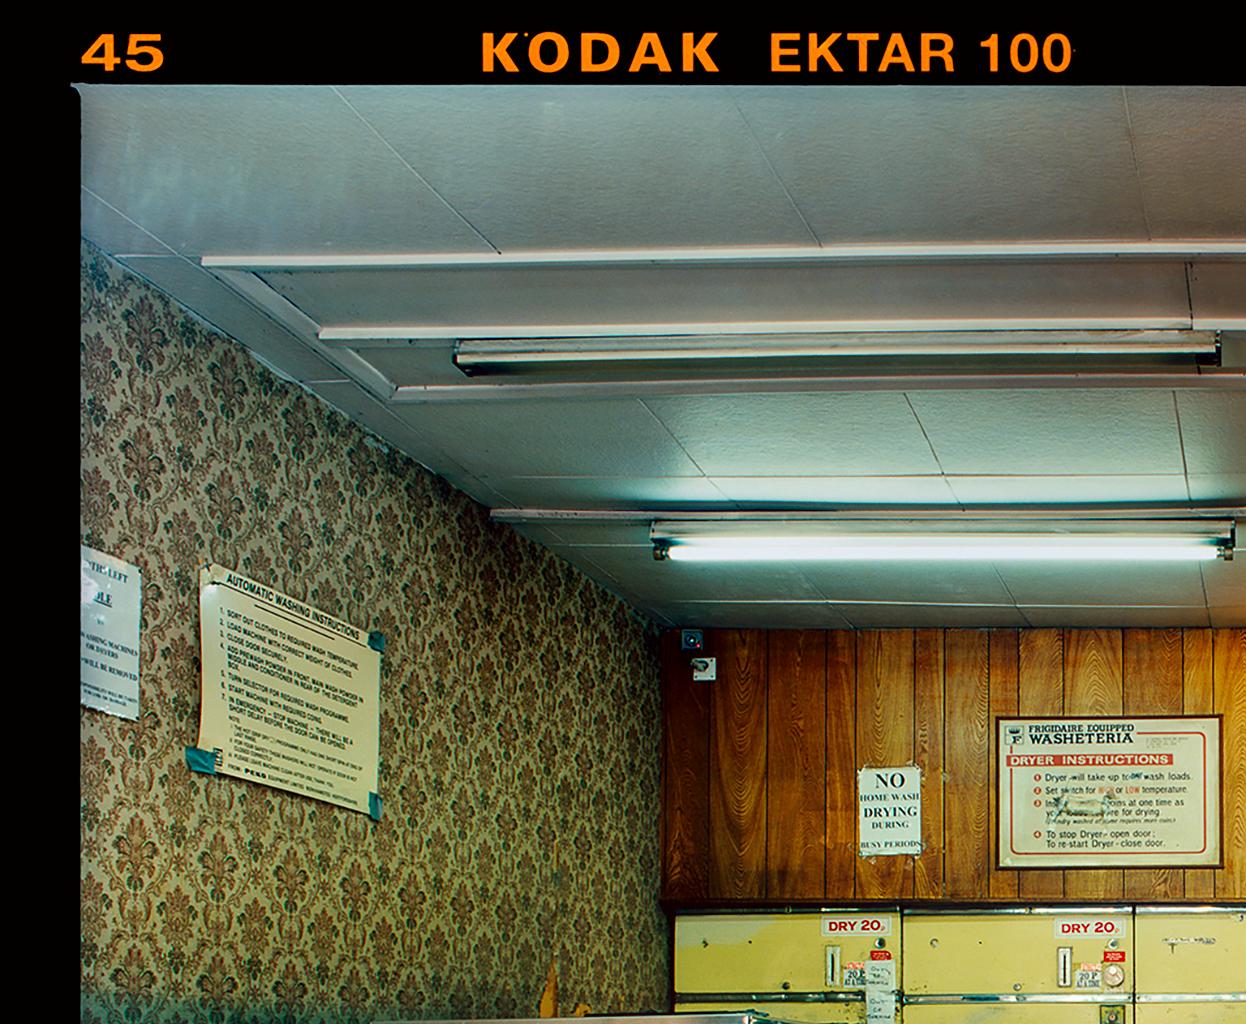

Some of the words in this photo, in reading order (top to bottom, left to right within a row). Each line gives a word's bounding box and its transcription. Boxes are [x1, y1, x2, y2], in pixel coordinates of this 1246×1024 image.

[226, 573, 274, 601] AUTOMATIC
[274, 594, 311, 618] WASHING
[312, 611, 359, 640] INSTRUCTIONS
[1028, 725, 1084, 733] FRIGIDAIRE
[1087, 724, 1134, 733] EQUIPPED
[1028, 733, 1134, 744] WASHETERIA
[1010, 756, 1054, 766] DRYER
[1062, 754, 1169, 765] INSTRUCTIONS
[875, 772, 906, 789] NO
[1045, 773, 1067, 783] Dryer
[1087, 773, 1105, 781] take
[1107, 775, 1120, 783] up
[1143, 772, 1165, 780] wash
[1045, 786, 1058, 795] Set
[1085, 786, 1096, 794] for
[860, 793, 888, 802] HOME
[891, 792, 920, 801] WASH
[1128, 799, 1137, 807] at
[1138, 799, 1153, 807] one
[1155, 799, 1172, 807] time
[1174, 799, 1185, 807] as
[864, 805, 917, 818] DRYING
[1122, 808, 1132, 816] for
[1135, 808, 1161, 818] drying
[871, 821, 909, 830] DURING
[1046, 831, 1056, 839] To
[1059, 831, 1077, 840] stop
[1080, 830, 1103, 840] Dryer
[1110, 832, 1130, 840] open
[860, 841, 882, 849] BUSY
[1046, 839, 1056, 848] To
[1092, 839, 1114, 849] Dryer
[1121, 839, 1143, 847] close
[829, 921, 857, 931] DRY
[1061, 923, 1090, 933] DRY
